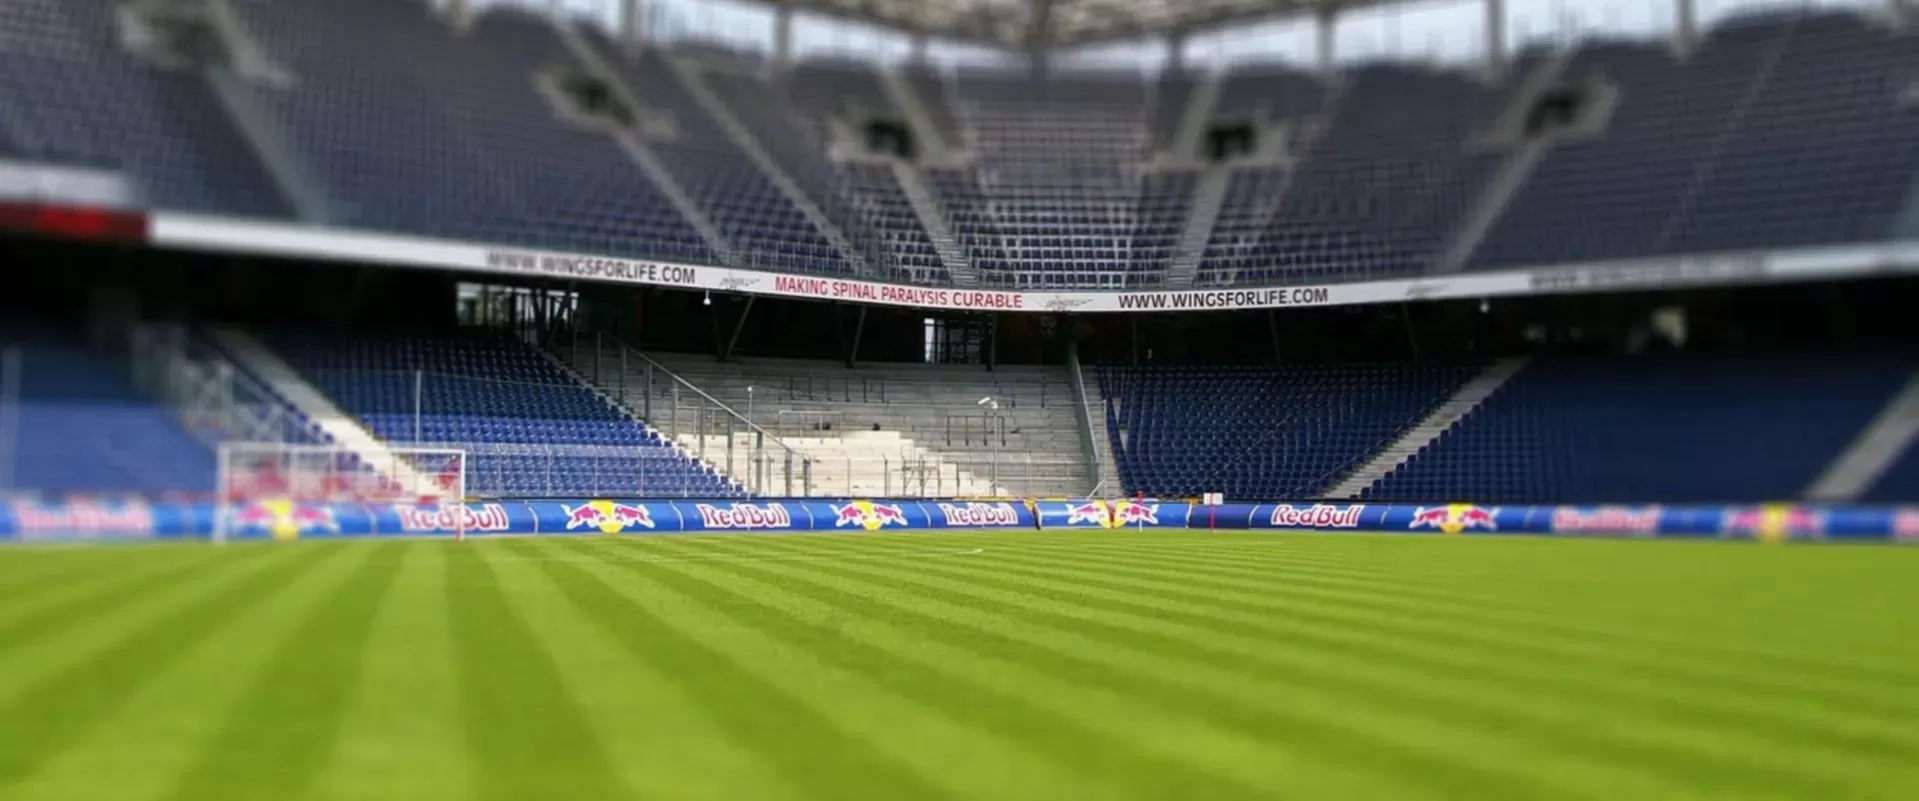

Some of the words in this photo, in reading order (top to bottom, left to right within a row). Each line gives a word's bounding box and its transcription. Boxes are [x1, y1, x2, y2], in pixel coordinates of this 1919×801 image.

[774, 276, 828, 295] MAKING
[832, 282, 877, 299] SPINAL
[881, 286, 947, 305] PARALYSIS
[953, 292, 1023, 308] CURABLE
[1119, 287, 1329, 308] WWW.WINGSFORLIFE.COM
